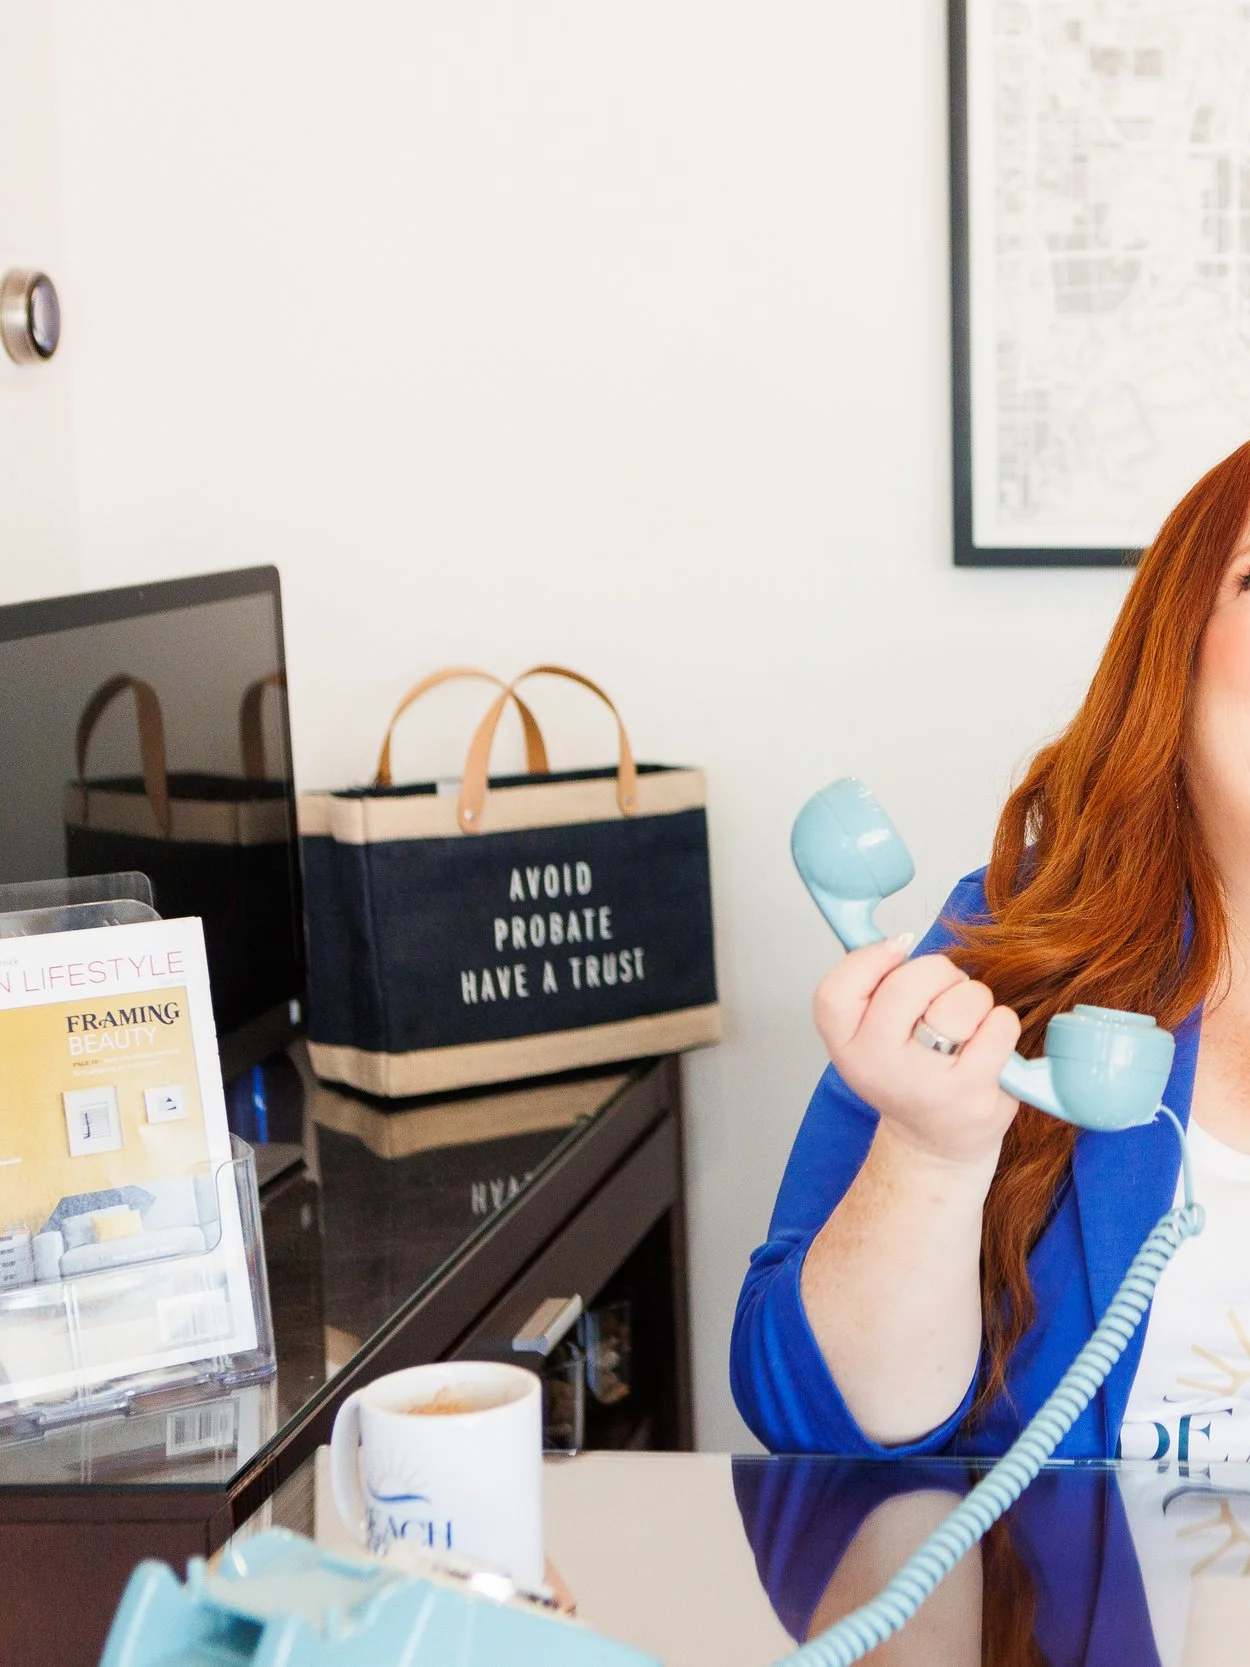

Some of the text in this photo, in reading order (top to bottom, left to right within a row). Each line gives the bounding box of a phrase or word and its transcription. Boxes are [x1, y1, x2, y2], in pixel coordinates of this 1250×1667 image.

[509, 861, 592, 902] AVOID
[494, 905, 614, 952] PROBATE
[22, 950, 185, 992] LIFESTYLE
[460, 946, 645, 1005] HAVE A TRUST
[65, 1001, 180, 1033] FRAMING
[68, 1026, 157, 1056] BEAUTY
